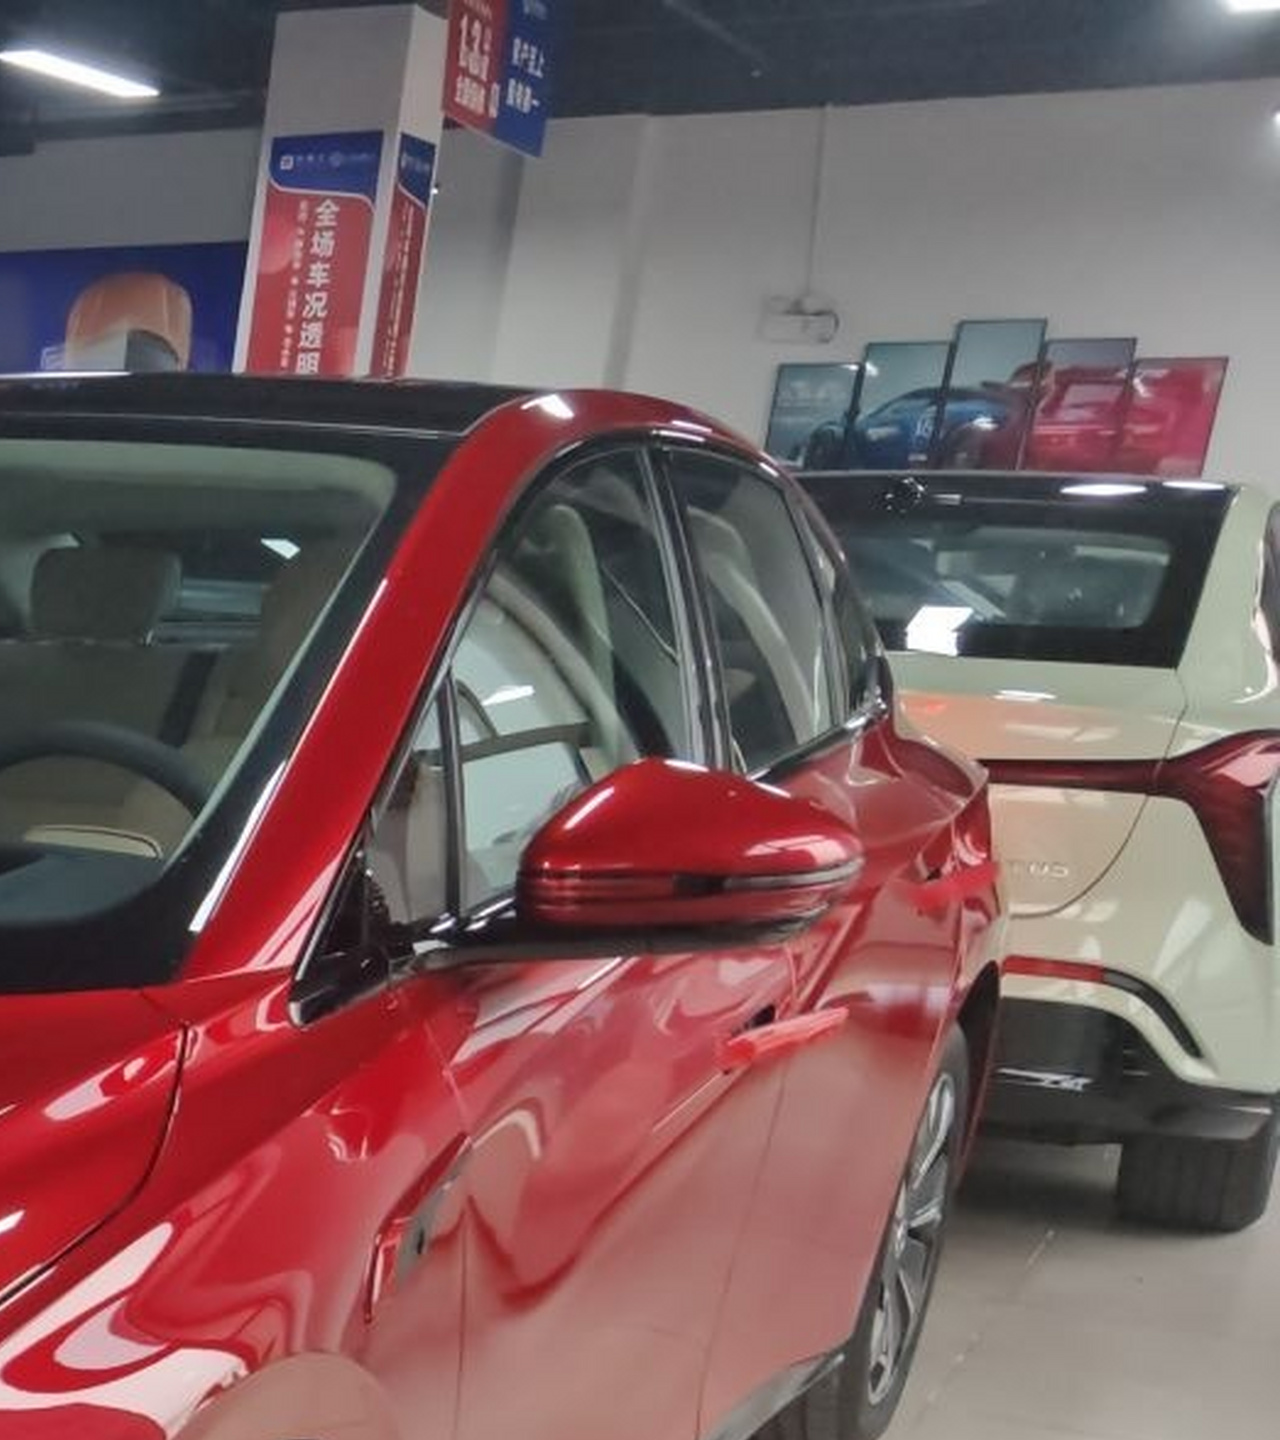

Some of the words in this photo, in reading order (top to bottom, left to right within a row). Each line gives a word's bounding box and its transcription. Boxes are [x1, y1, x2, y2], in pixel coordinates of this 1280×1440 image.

[295, 198, 340, 374] 全场车况透明
